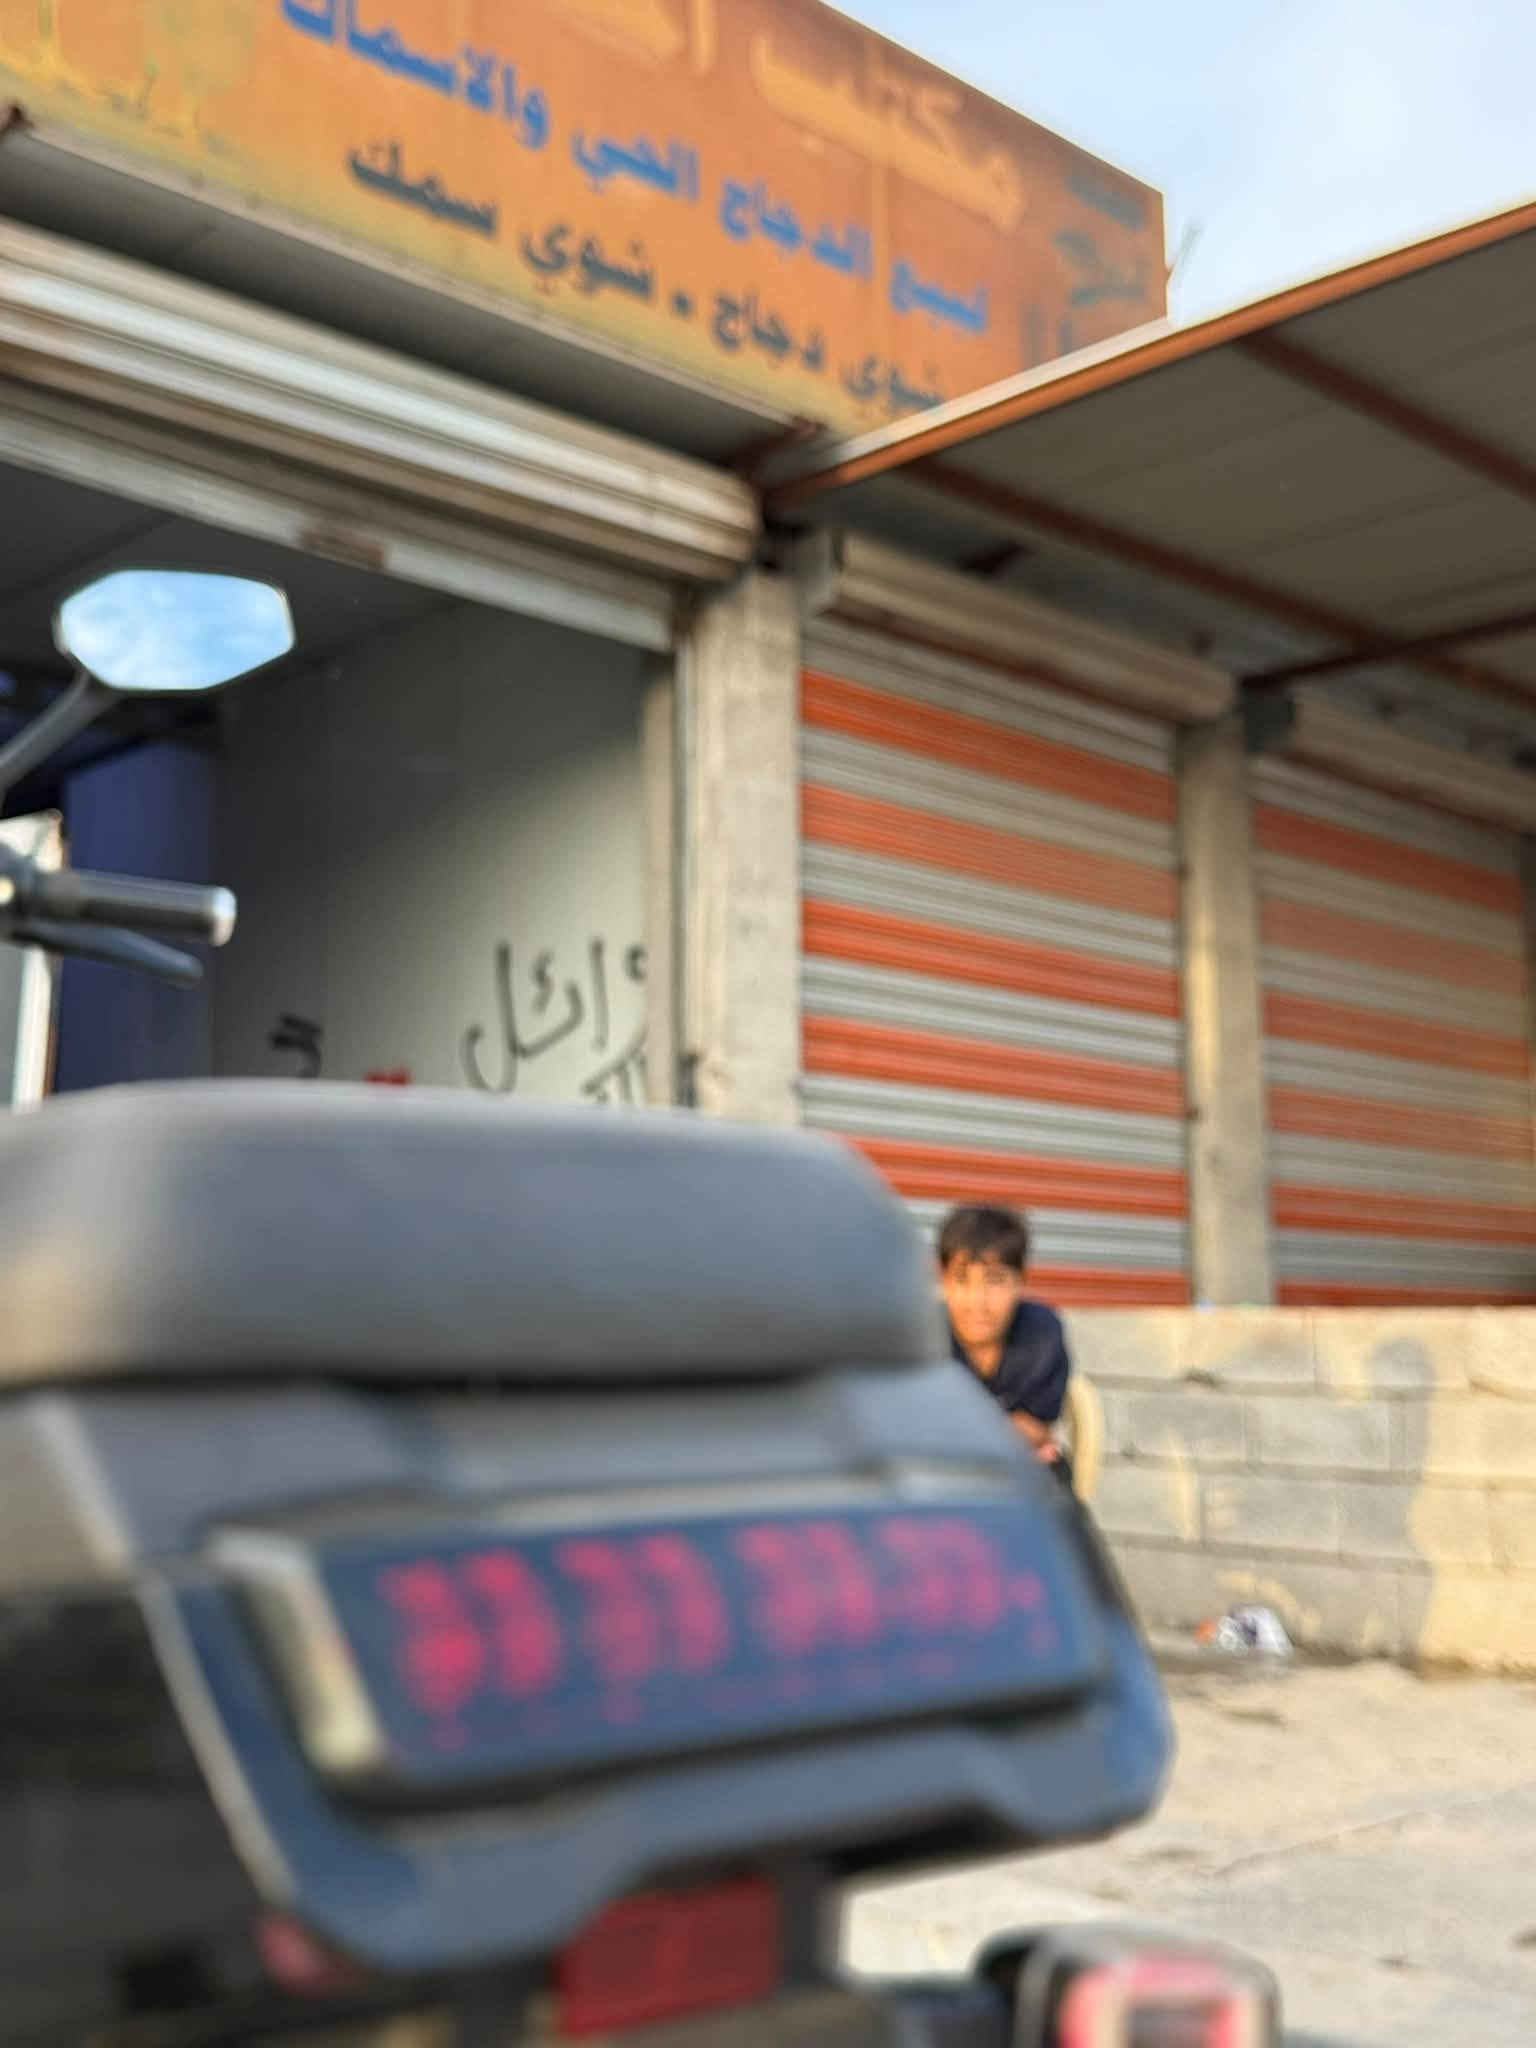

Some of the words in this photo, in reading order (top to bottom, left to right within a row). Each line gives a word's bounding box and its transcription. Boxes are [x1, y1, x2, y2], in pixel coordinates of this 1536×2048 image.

[346, 136, 500, 238] سمك
[719, 178, 874, 282] الدجاج
[711, 286, 827, 371] دجاج
